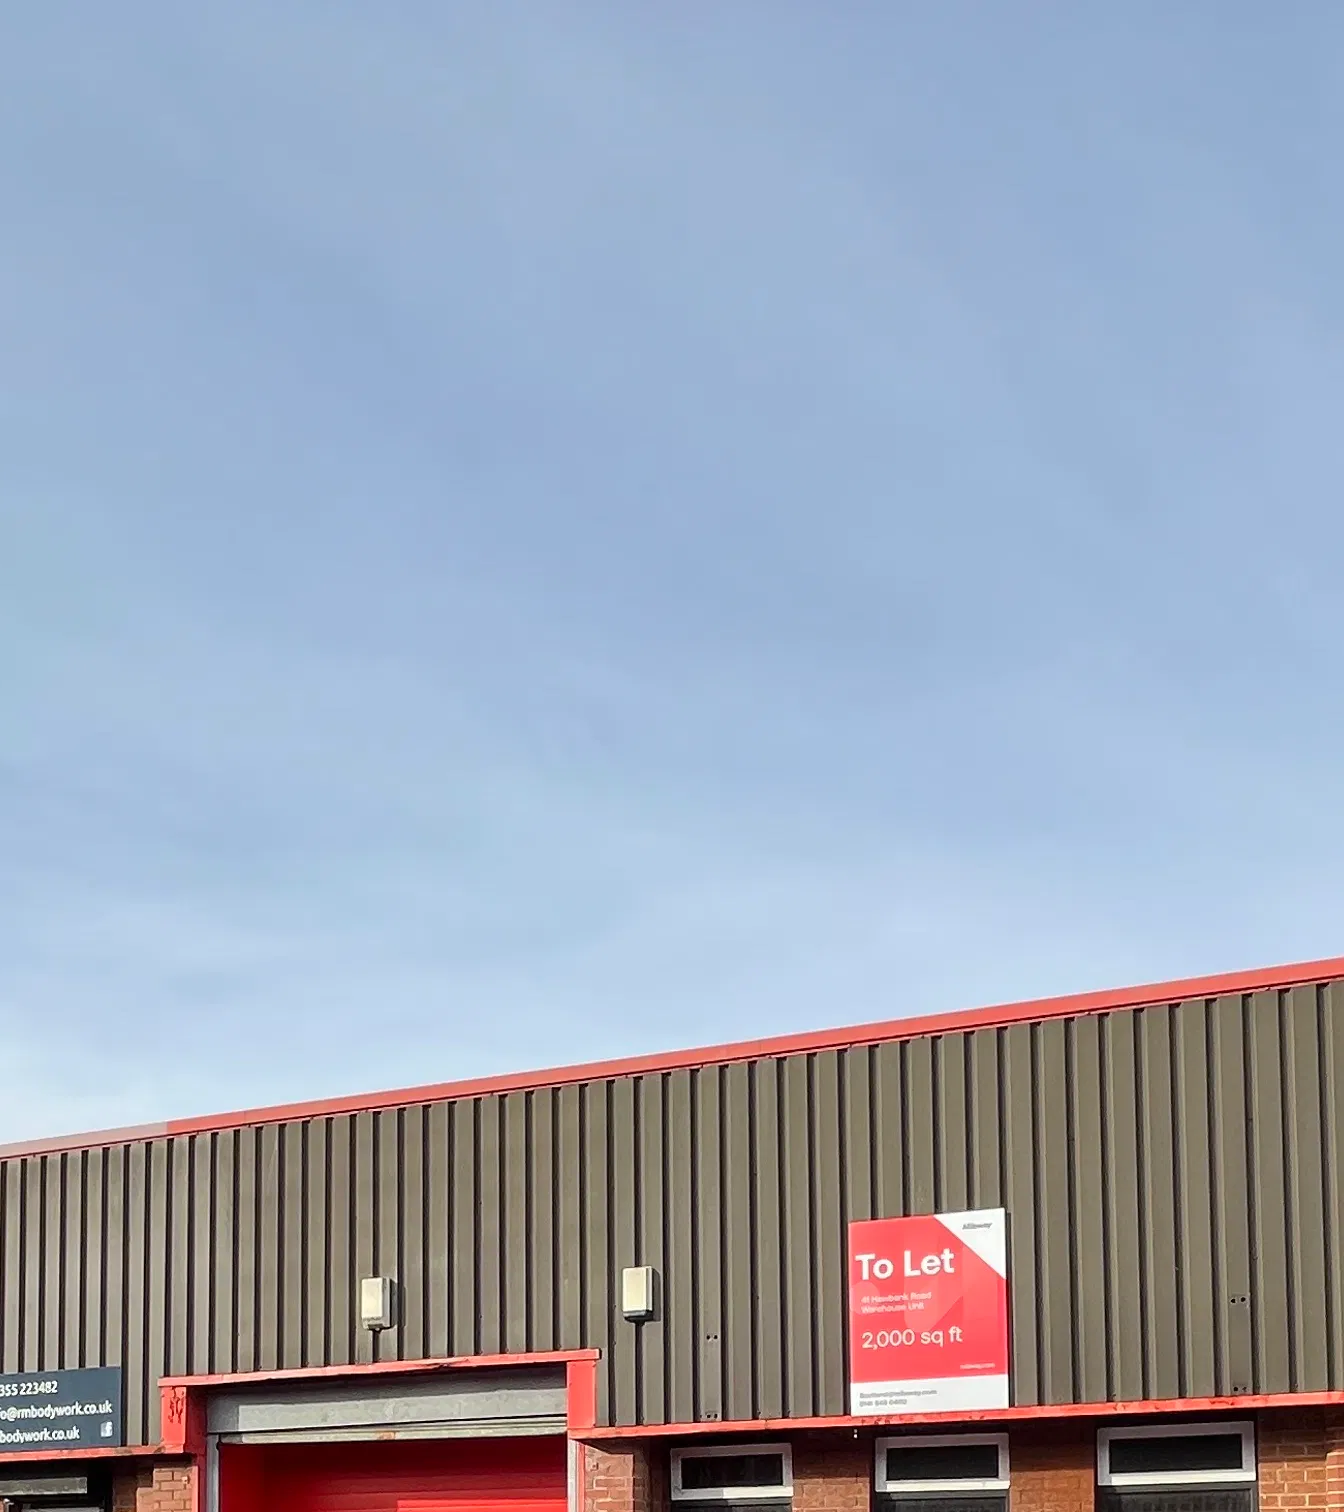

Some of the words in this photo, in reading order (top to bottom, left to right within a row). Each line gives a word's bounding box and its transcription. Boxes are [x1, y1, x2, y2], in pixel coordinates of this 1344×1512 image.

[855, 1253, 894, 1281] To
[904, 1248, 955, 1277] Let
[862, 1329, 916, 1351] 2,000
[920, 1330, 944, 1348] sq
[949, 1326, 963, 1343] ft
